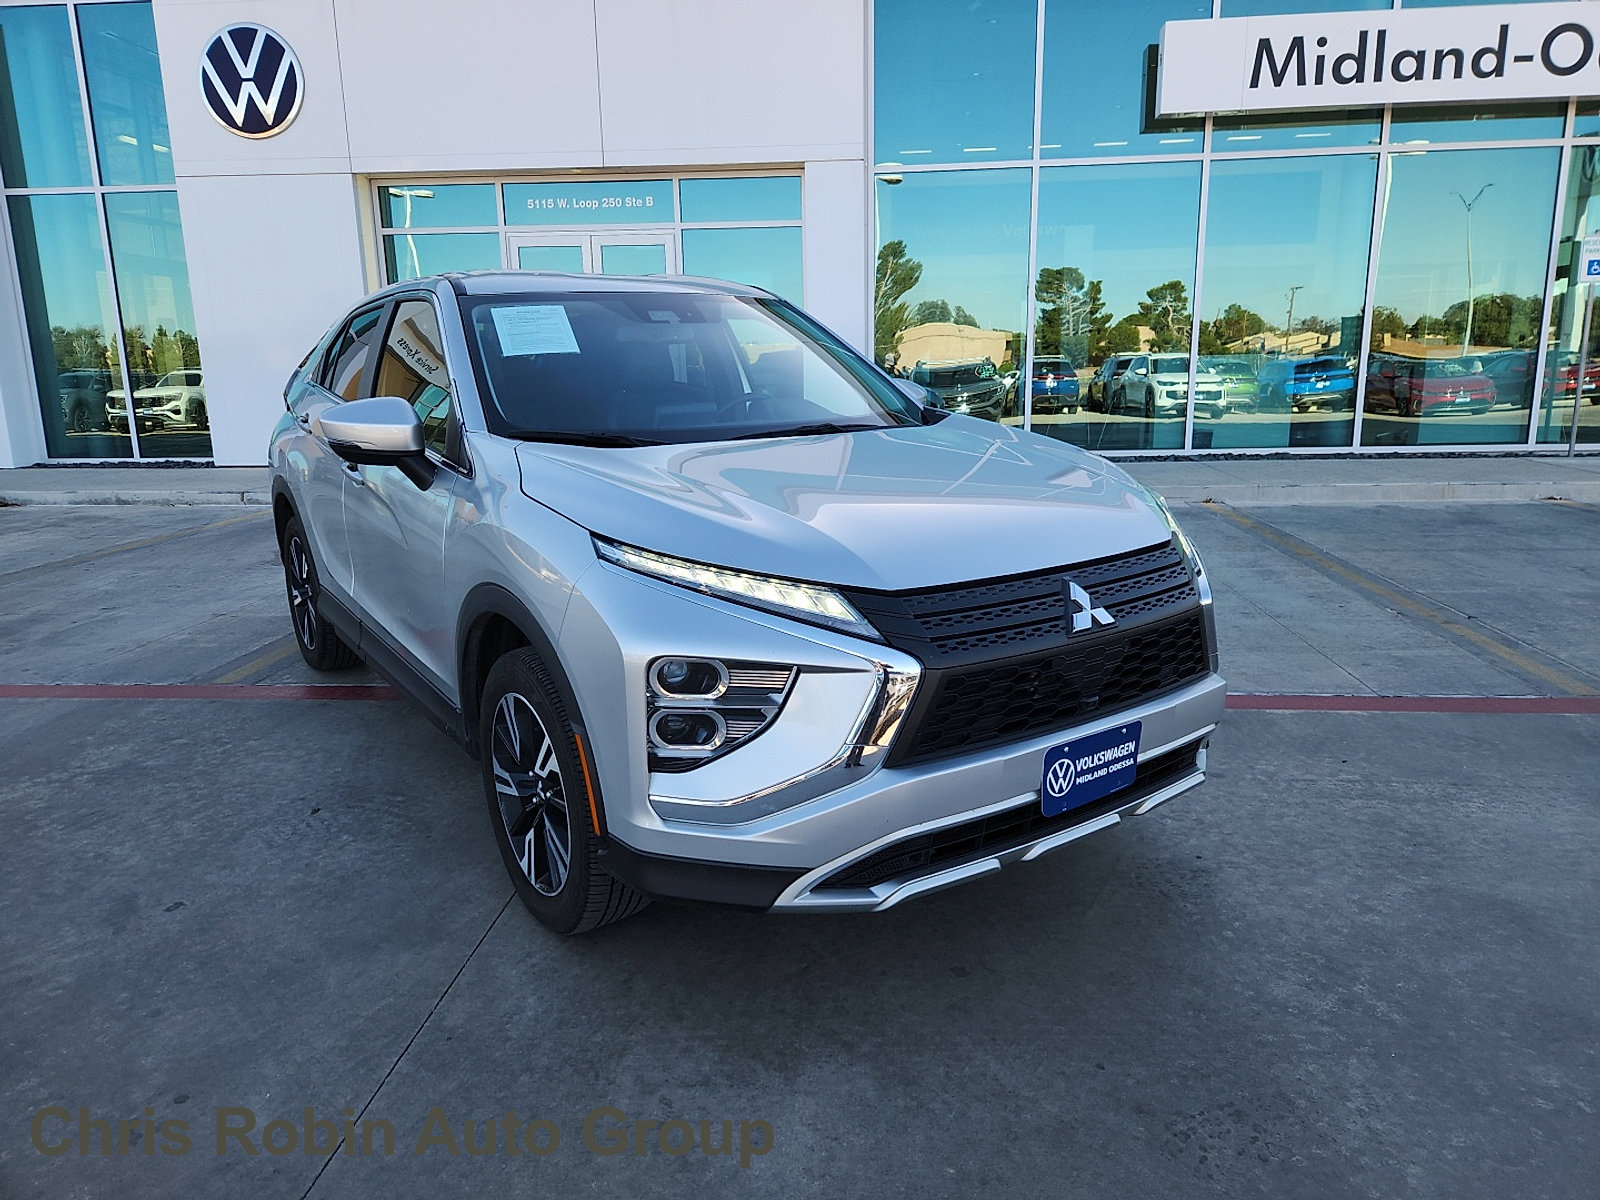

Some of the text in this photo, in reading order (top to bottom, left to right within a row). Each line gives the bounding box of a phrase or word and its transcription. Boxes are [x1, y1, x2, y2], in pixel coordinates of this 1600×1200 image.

[1249, 22, 1600, 89] Midland-O
[527, 196, 654, 210] 5115 W. Loop 250 Ste B
[1075, 740, 1136, 773] VOLKSWAGEN
[1075, 757, 1135, 786] MIDLAND ODESSA
